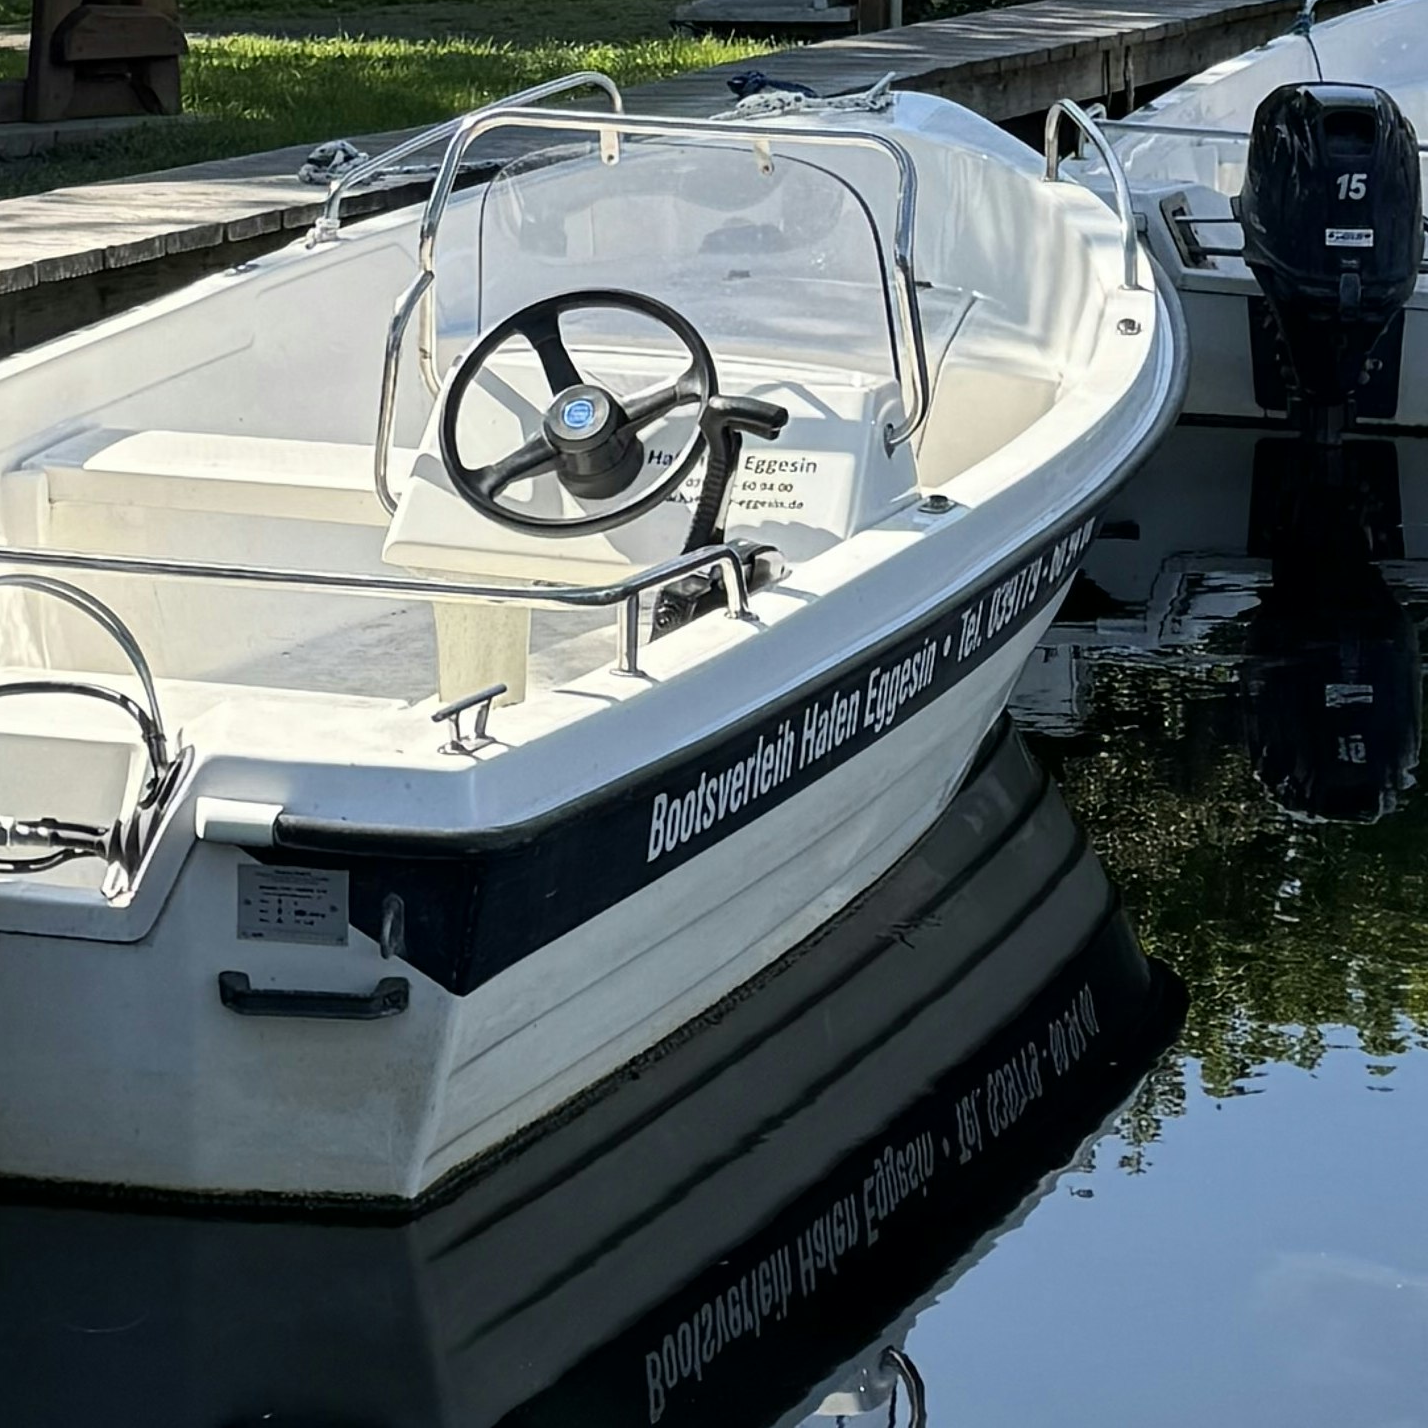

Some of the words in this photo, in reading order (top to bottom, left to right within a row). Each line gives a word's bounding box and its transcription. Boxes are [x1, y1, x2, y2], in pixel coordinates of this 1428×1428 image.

[1336, 173, 1367, 200] 15
[744, 455, 818, 475] Eggesin
[778, 483, 794, 493] 00
[647, 725, 796, 862] Bootsverleih
[799, 689, 858, 771] Hafen
[864, 638, 937, 734] Eggesin
[957, 600, 984, 662] Tel.
[987, 557, 1043, 639] 039779
